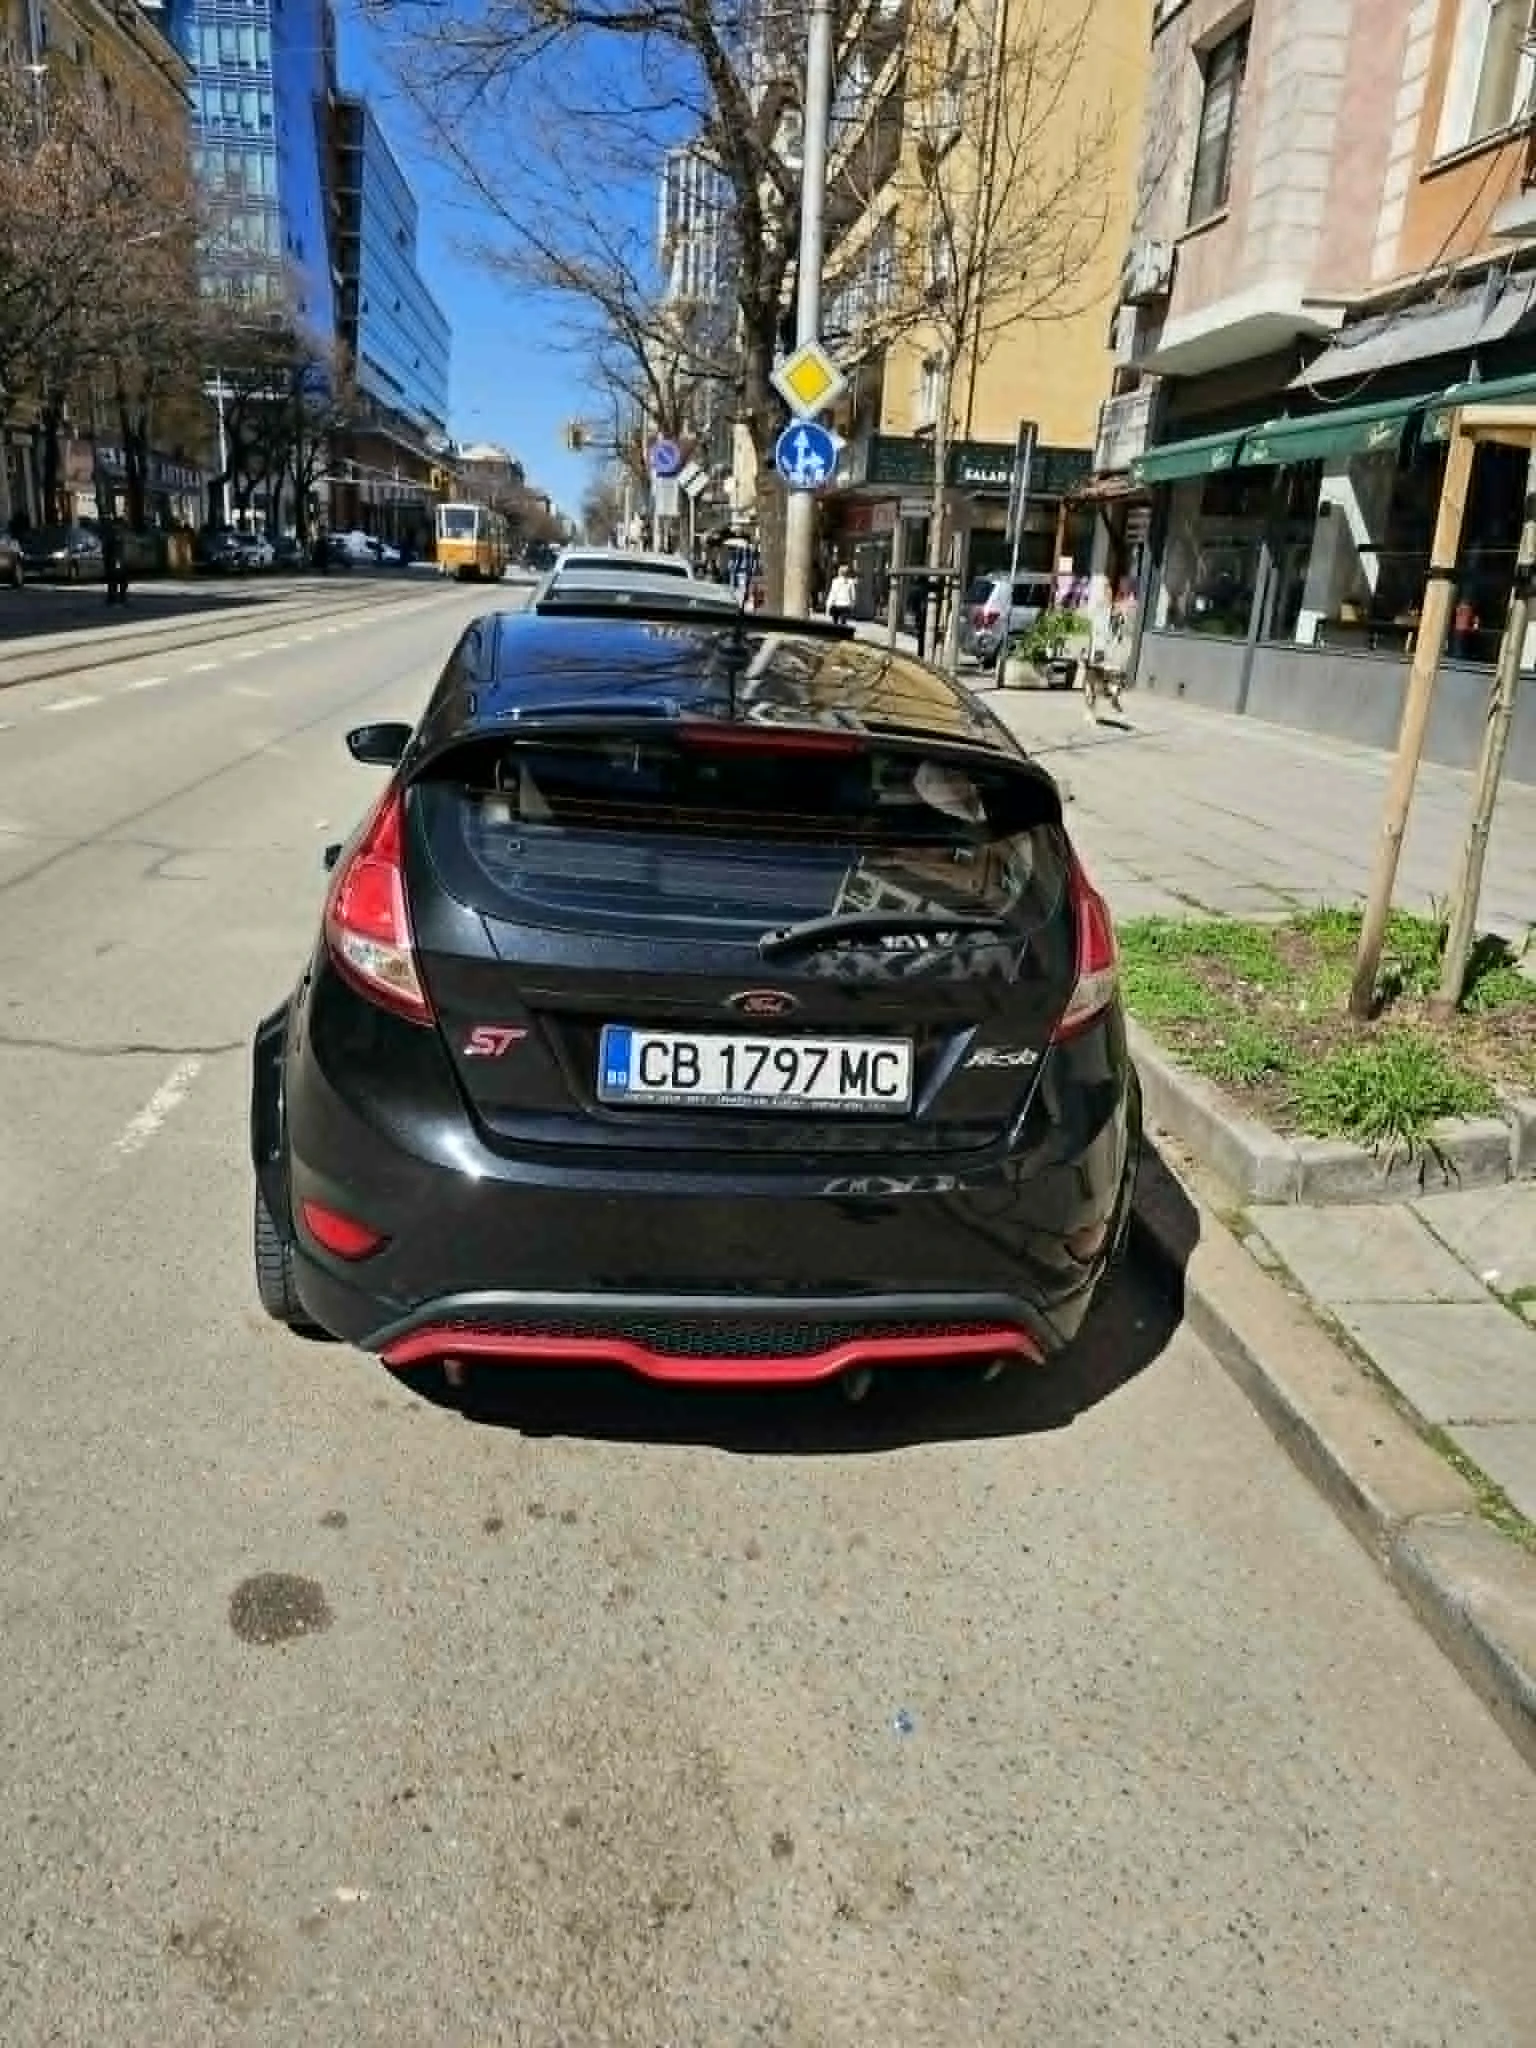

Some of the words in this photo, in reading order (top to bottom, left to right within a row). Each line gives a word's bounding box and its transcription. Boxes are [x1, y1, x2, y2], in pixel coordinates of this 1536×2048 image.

[463, 1026, 528, 1057] ST
[639, 1040, 701, 1089] CB
[720, 1044, 829, 1094] 1797
[839, 1048, 899, 1097] MC
